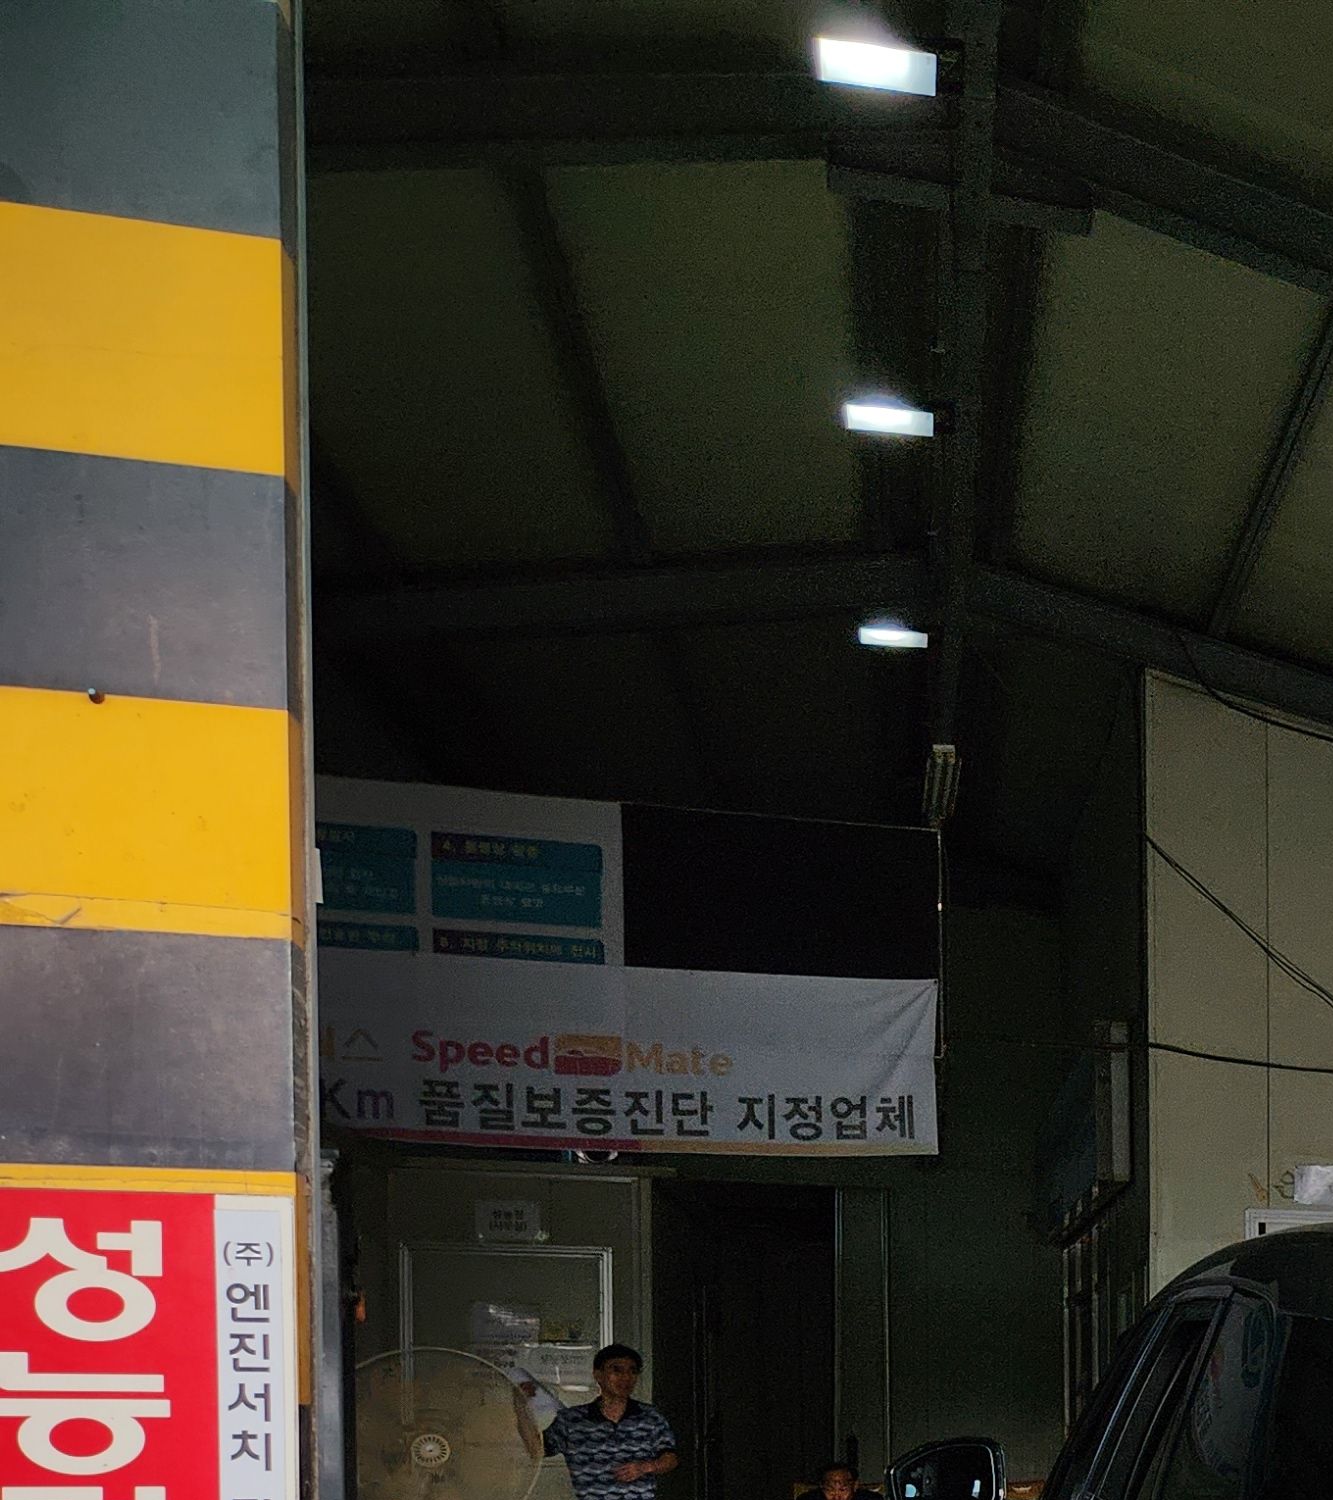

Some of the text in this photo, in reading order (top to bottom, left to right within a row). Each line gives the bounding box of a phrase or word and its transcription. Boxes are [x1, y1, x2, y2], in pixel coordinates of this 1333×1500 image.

[410, 1030, 551, 1073] Speed
[626, 1040, 734, 1077] Mate
[417, 1079, 714, 1138] 품질보증진단
[736, 1094, 917, 1142] 지정업체
